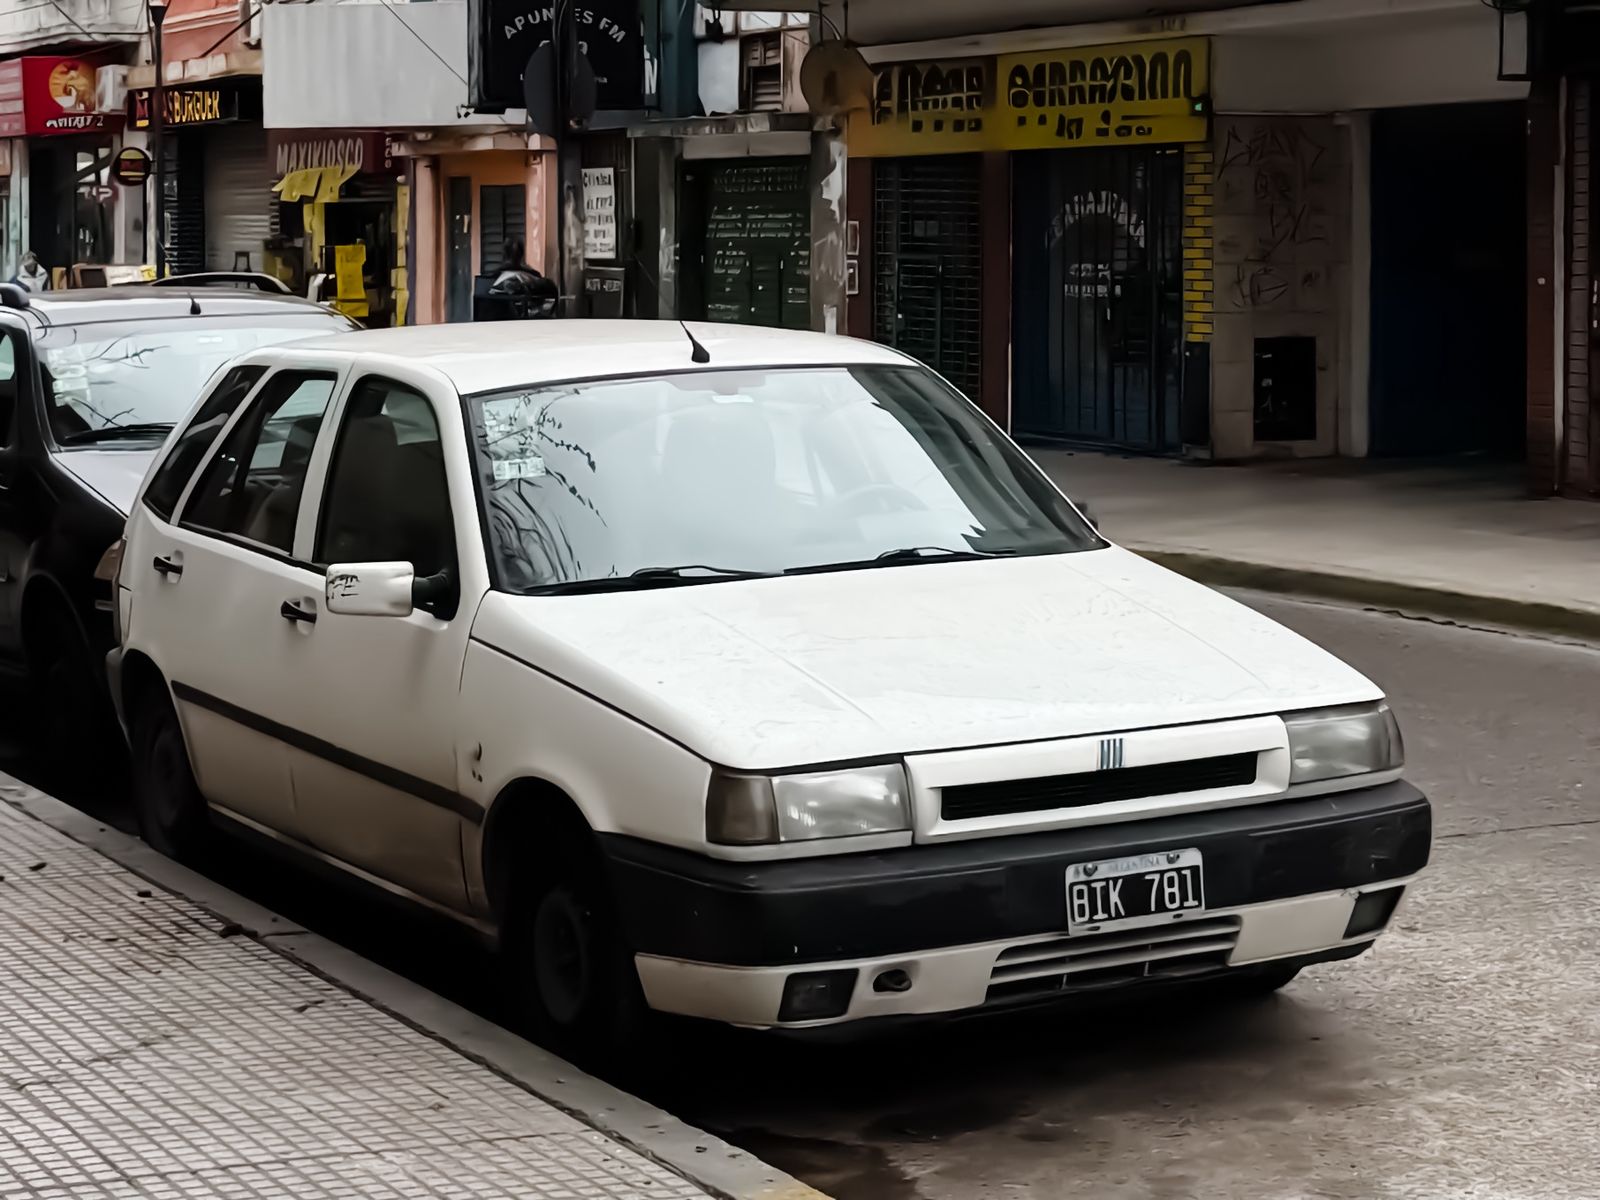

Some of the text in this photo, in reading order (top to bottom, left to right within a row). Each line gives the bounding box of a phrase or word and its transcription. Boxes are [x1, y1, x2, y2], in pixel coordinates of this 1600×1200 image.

[504, 7, 626, 43] APUNES FM
[276, 137, 364, 174] MAXIKIOSCO
[1144, 868, 1199, 912] 781
